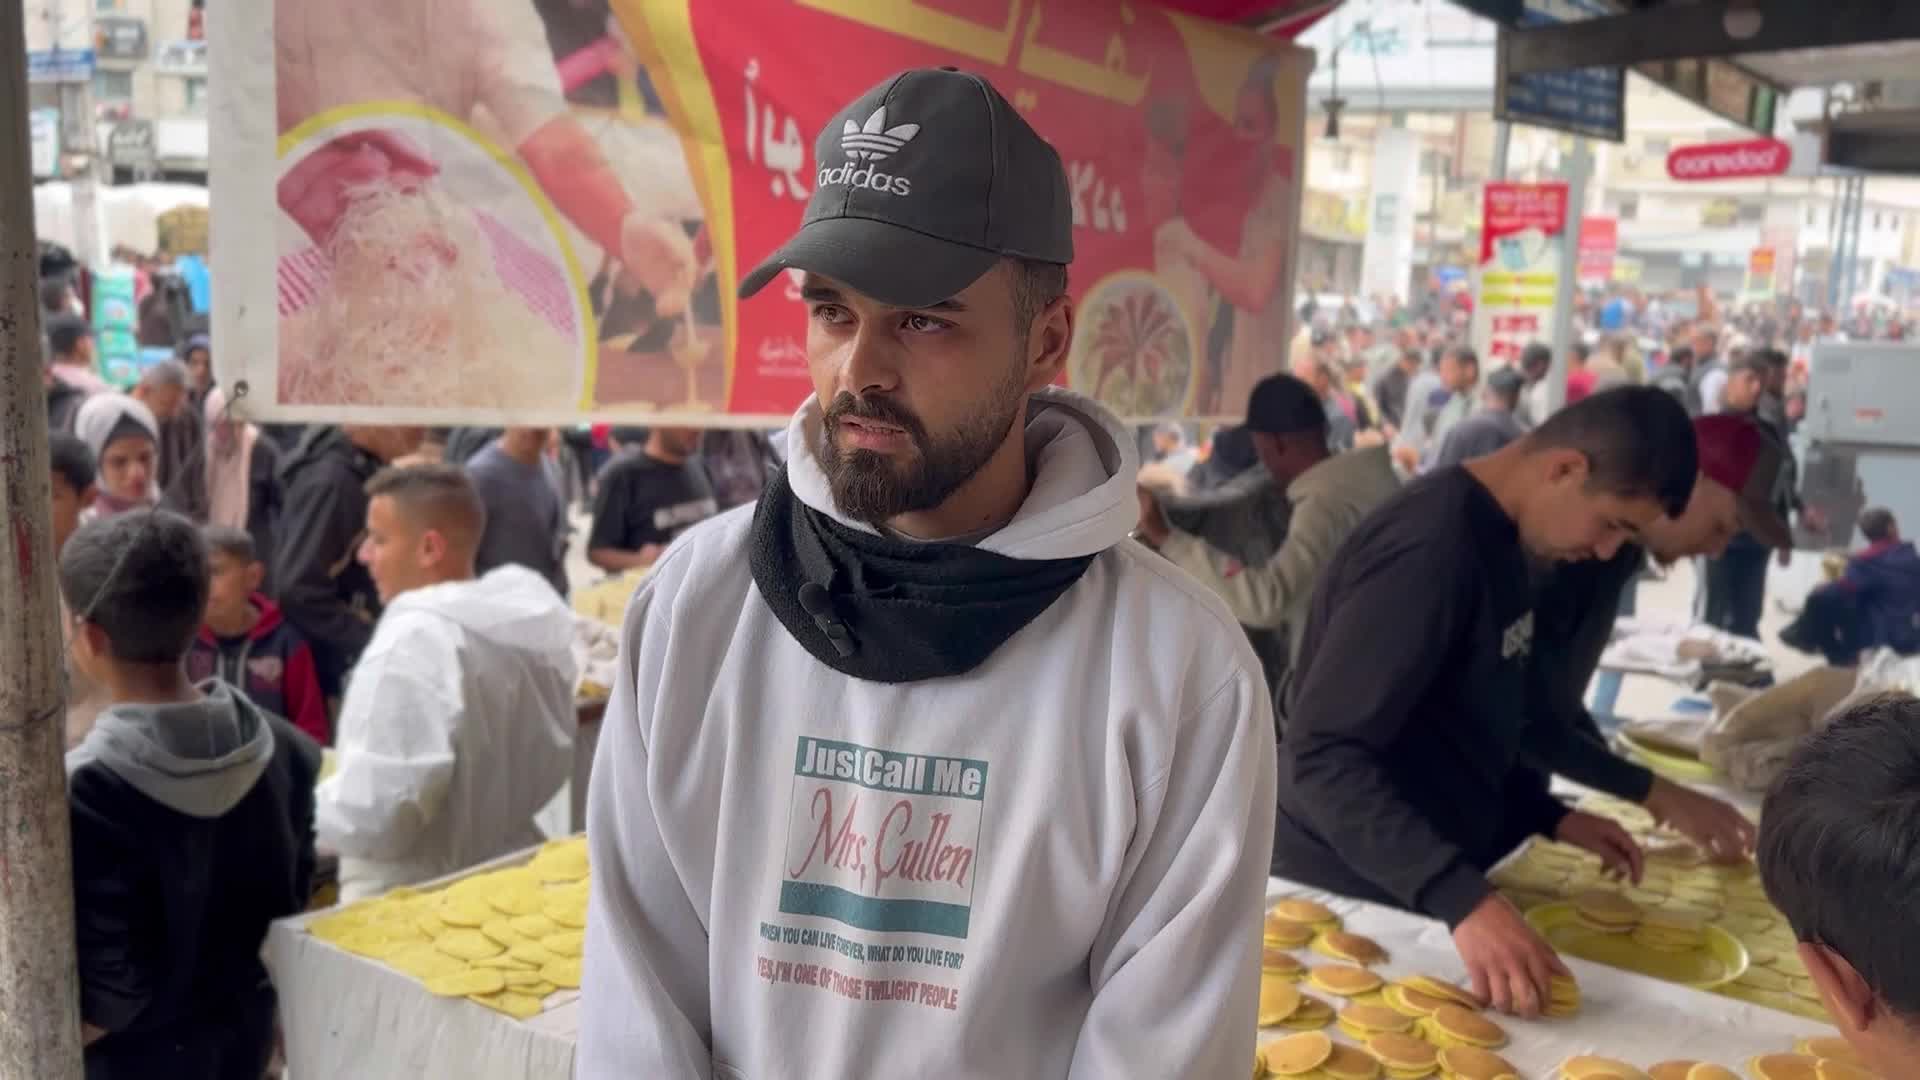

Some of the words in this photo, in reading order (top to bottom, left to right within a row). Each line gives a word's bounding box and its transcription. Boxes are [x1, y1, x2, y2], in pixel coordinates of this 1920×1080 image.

[817, 160, 912, 197] adidas
[802, 739, 862, 781] Just
[863, 750, 928, 791] Call
[932, 759, 982, 796] Me
[874, 799, 973, 896] Cullen
[760, 921, 781, 943] WHEN
[783, 927, 801, 944] YOU
[801, 928, 820, 947] CAN
[820, 931, 837, 951] LIVE
[867, 944, 892, 962] WHAT
[892, 946, 905, 962] DO
[906, 946, 924, 964] YOU
[924, 948, 944, 967] LIVE
[943, 950, 965, 970] FOR?
[793, 963, 819, 986] ONE
[819, 967, 833, 989] OF
[832, 970, 863, 1000] THOSE
[863, 980, 920, 1003] TWILIGHT
[919, 982, 960, 1011] PEOPLE
